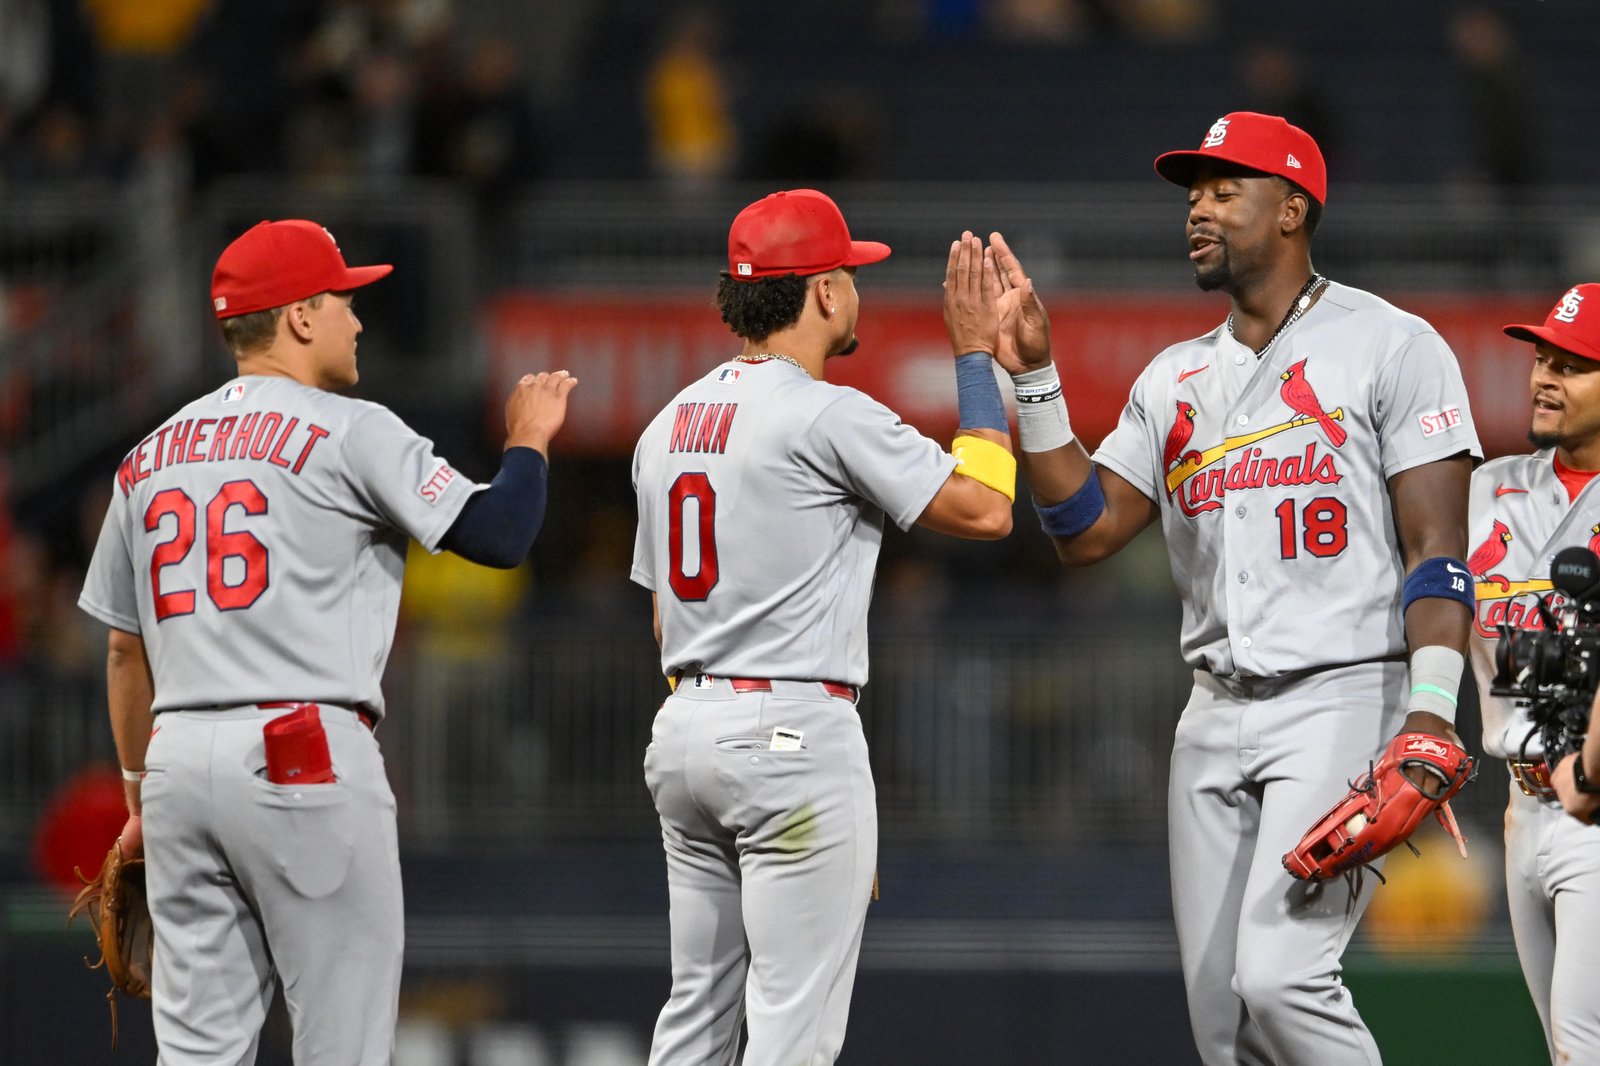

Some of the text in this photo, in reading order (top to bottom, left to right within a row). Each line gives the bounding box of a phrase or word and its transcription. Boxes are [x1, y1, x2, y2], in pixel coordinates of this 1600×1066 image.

[117, 411, 331, 499] WETHERHOLT
[668, 402, 739, 455] WINN
[1176, 441, 1344, 519] Cardinals
[143, 478, 270, 624] 26
[668, 471, 720, 602] 0
[1274, 496, 1349, 561] 18
[1451, 575, 1465, 592] 18
